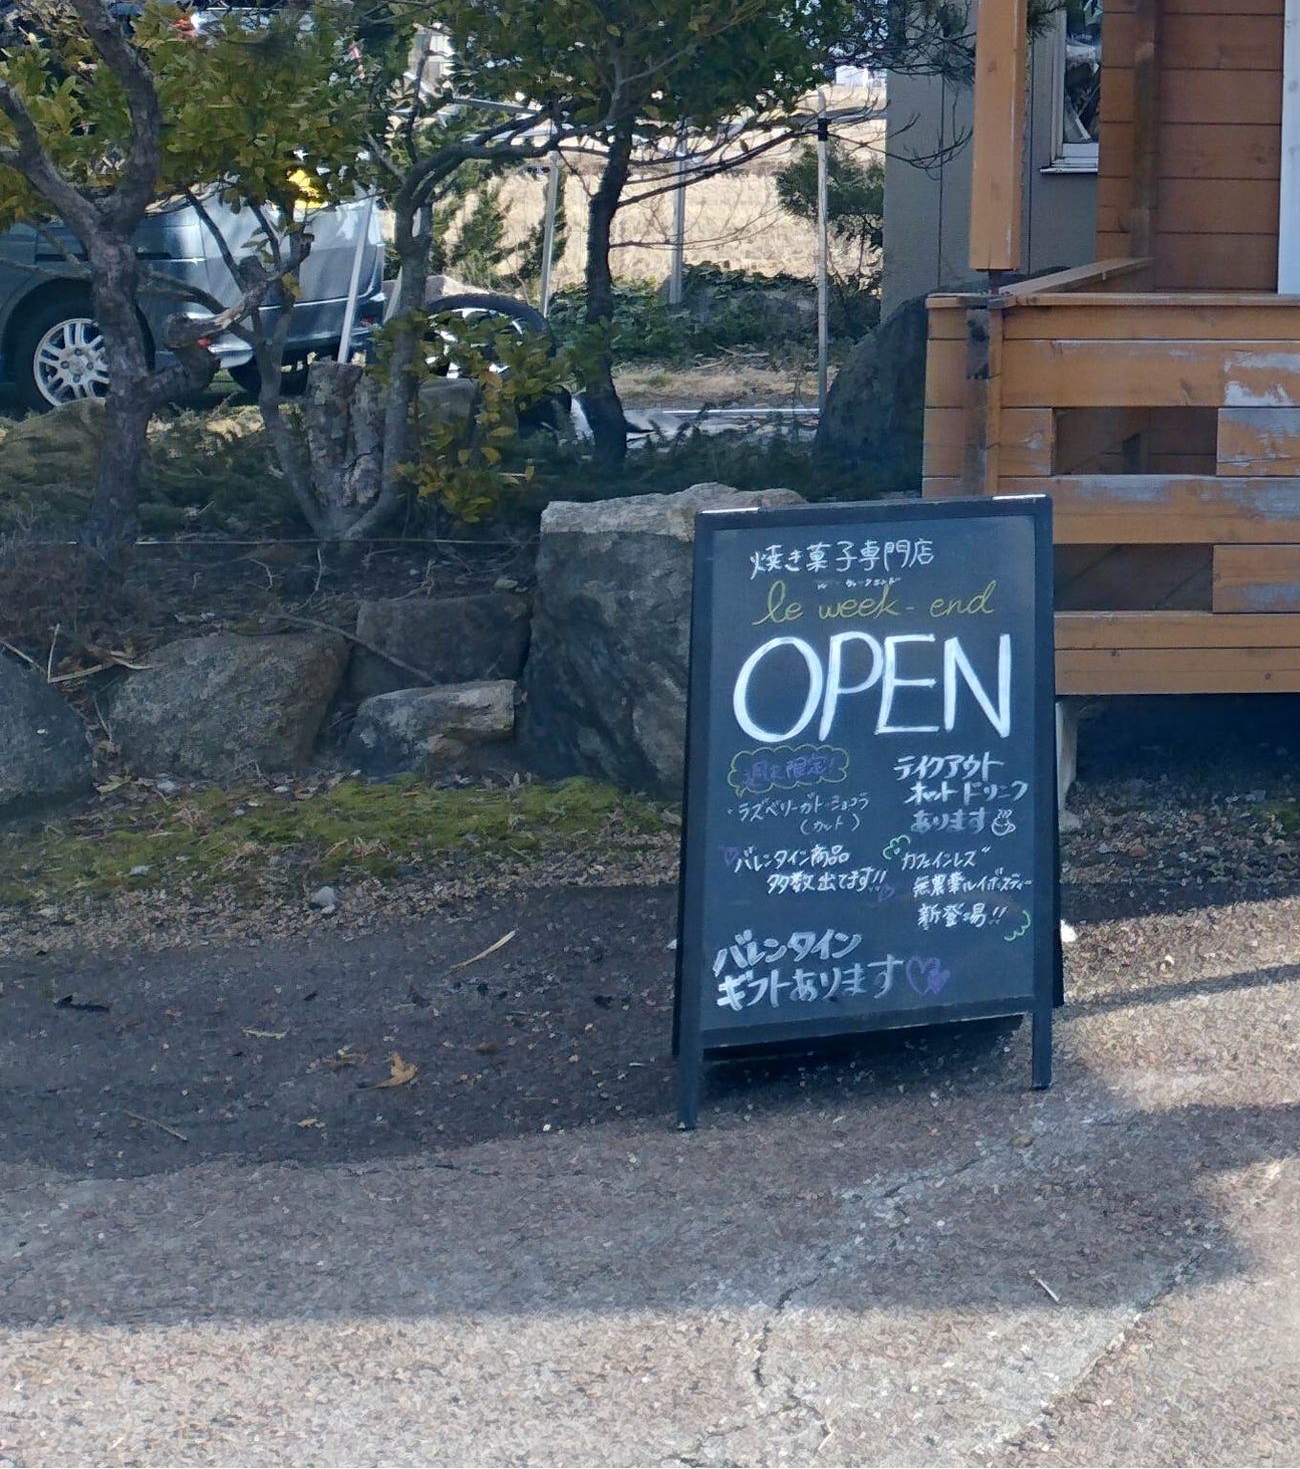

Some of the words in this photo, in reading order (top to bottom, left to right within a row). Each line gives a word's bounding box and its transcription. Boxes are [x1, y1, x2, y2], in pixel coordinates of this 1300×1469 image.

[750, 538, 934, 580] 焼き菓子専門店
[752, 580, 804, 625] le
[930, 580, 997, 618] end
[733, 631, 1011, 743] OPEN
[894, 751, 1005, 782] テイクアウト
[910, 807, 990, 834] あります
[734, 843, 850, 873] バレンタイン商品
[712, 929, 862, 977] バレンタイン
[716, 953, 904, 1011] ギフトあります
